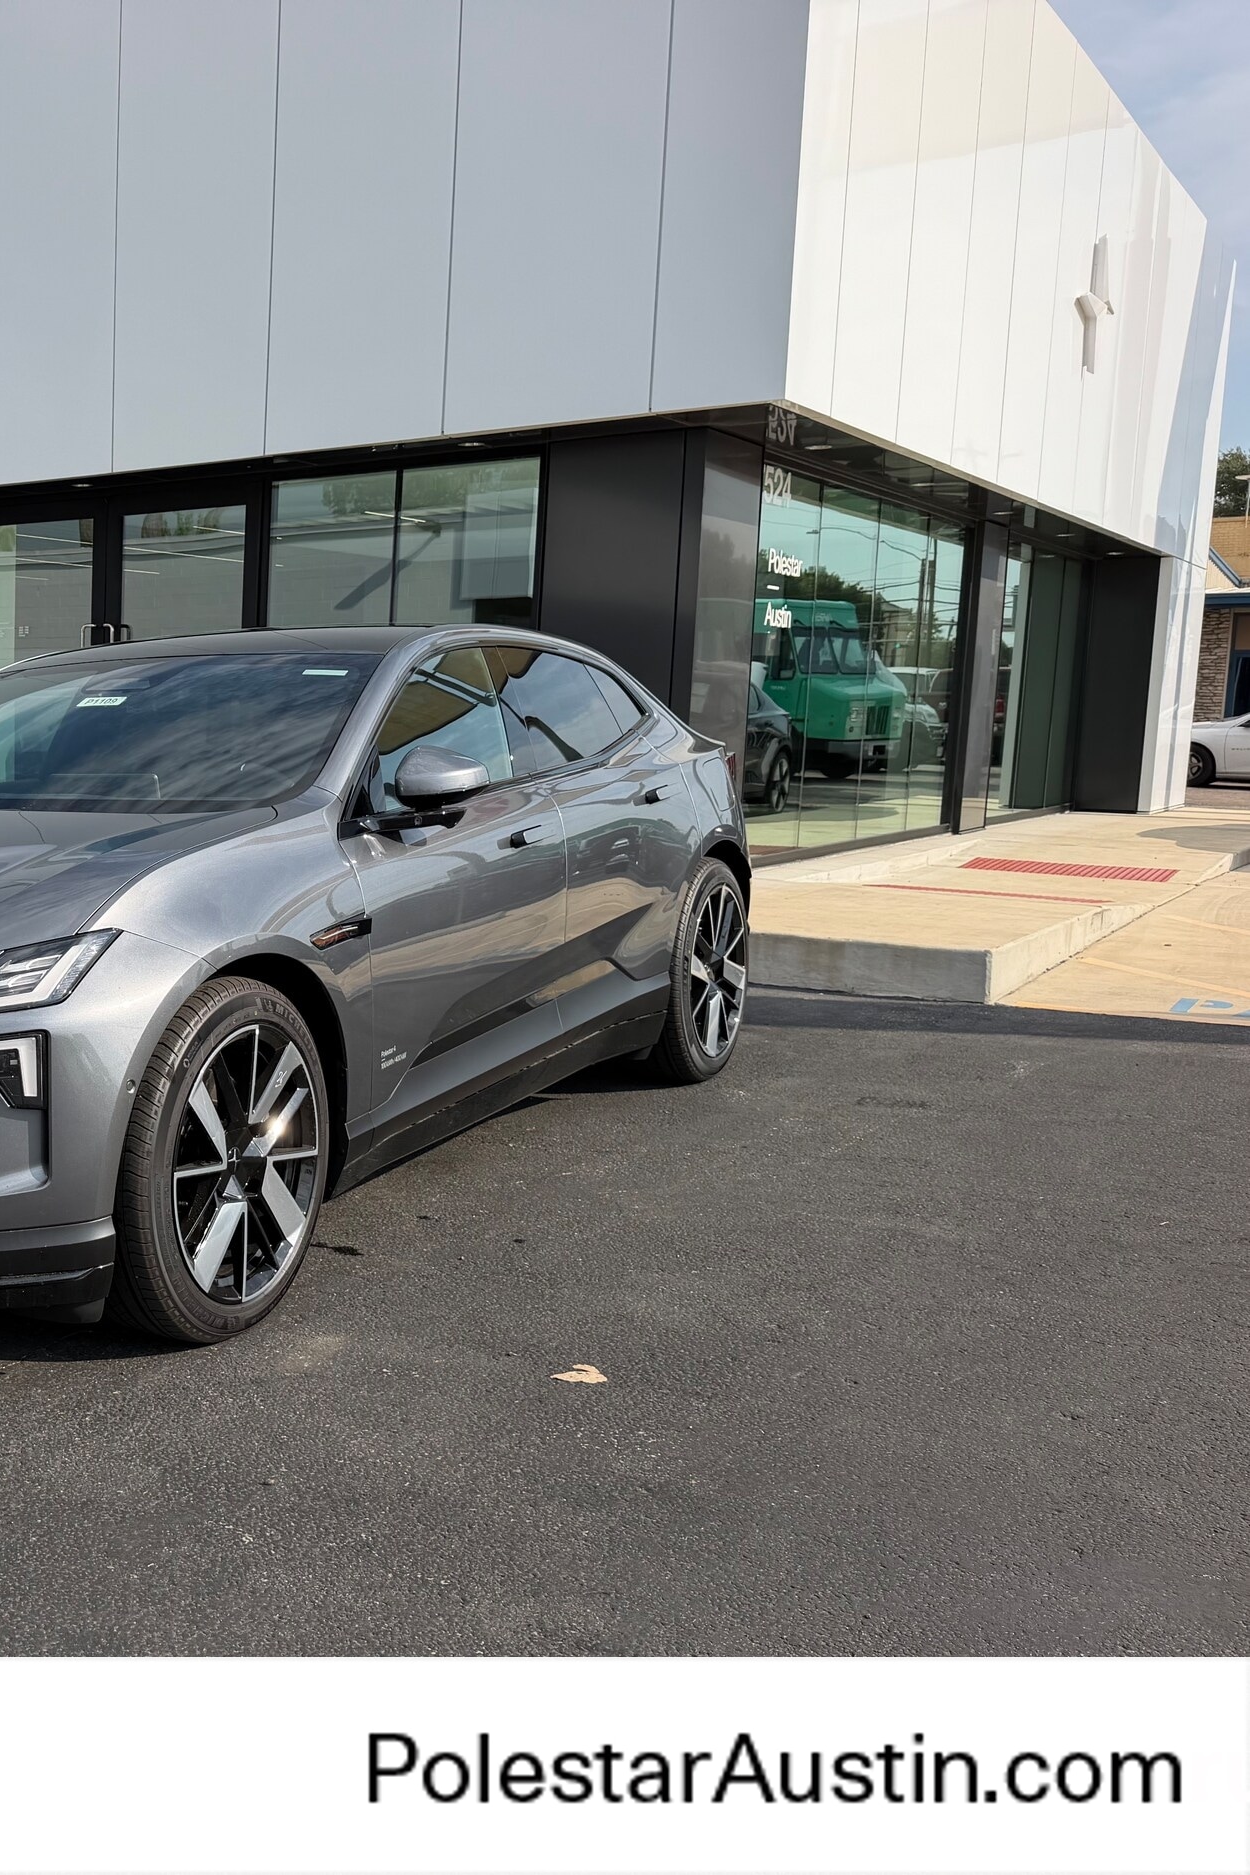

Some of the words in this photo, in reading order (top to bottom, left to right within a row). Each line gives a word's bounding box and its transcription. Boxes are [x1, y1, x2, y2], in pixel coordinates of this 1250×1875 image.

[762, 464, 792, 508] 524
[768, 548, 803, 577] Polestar
[764, 601, 792, 629] Austin
